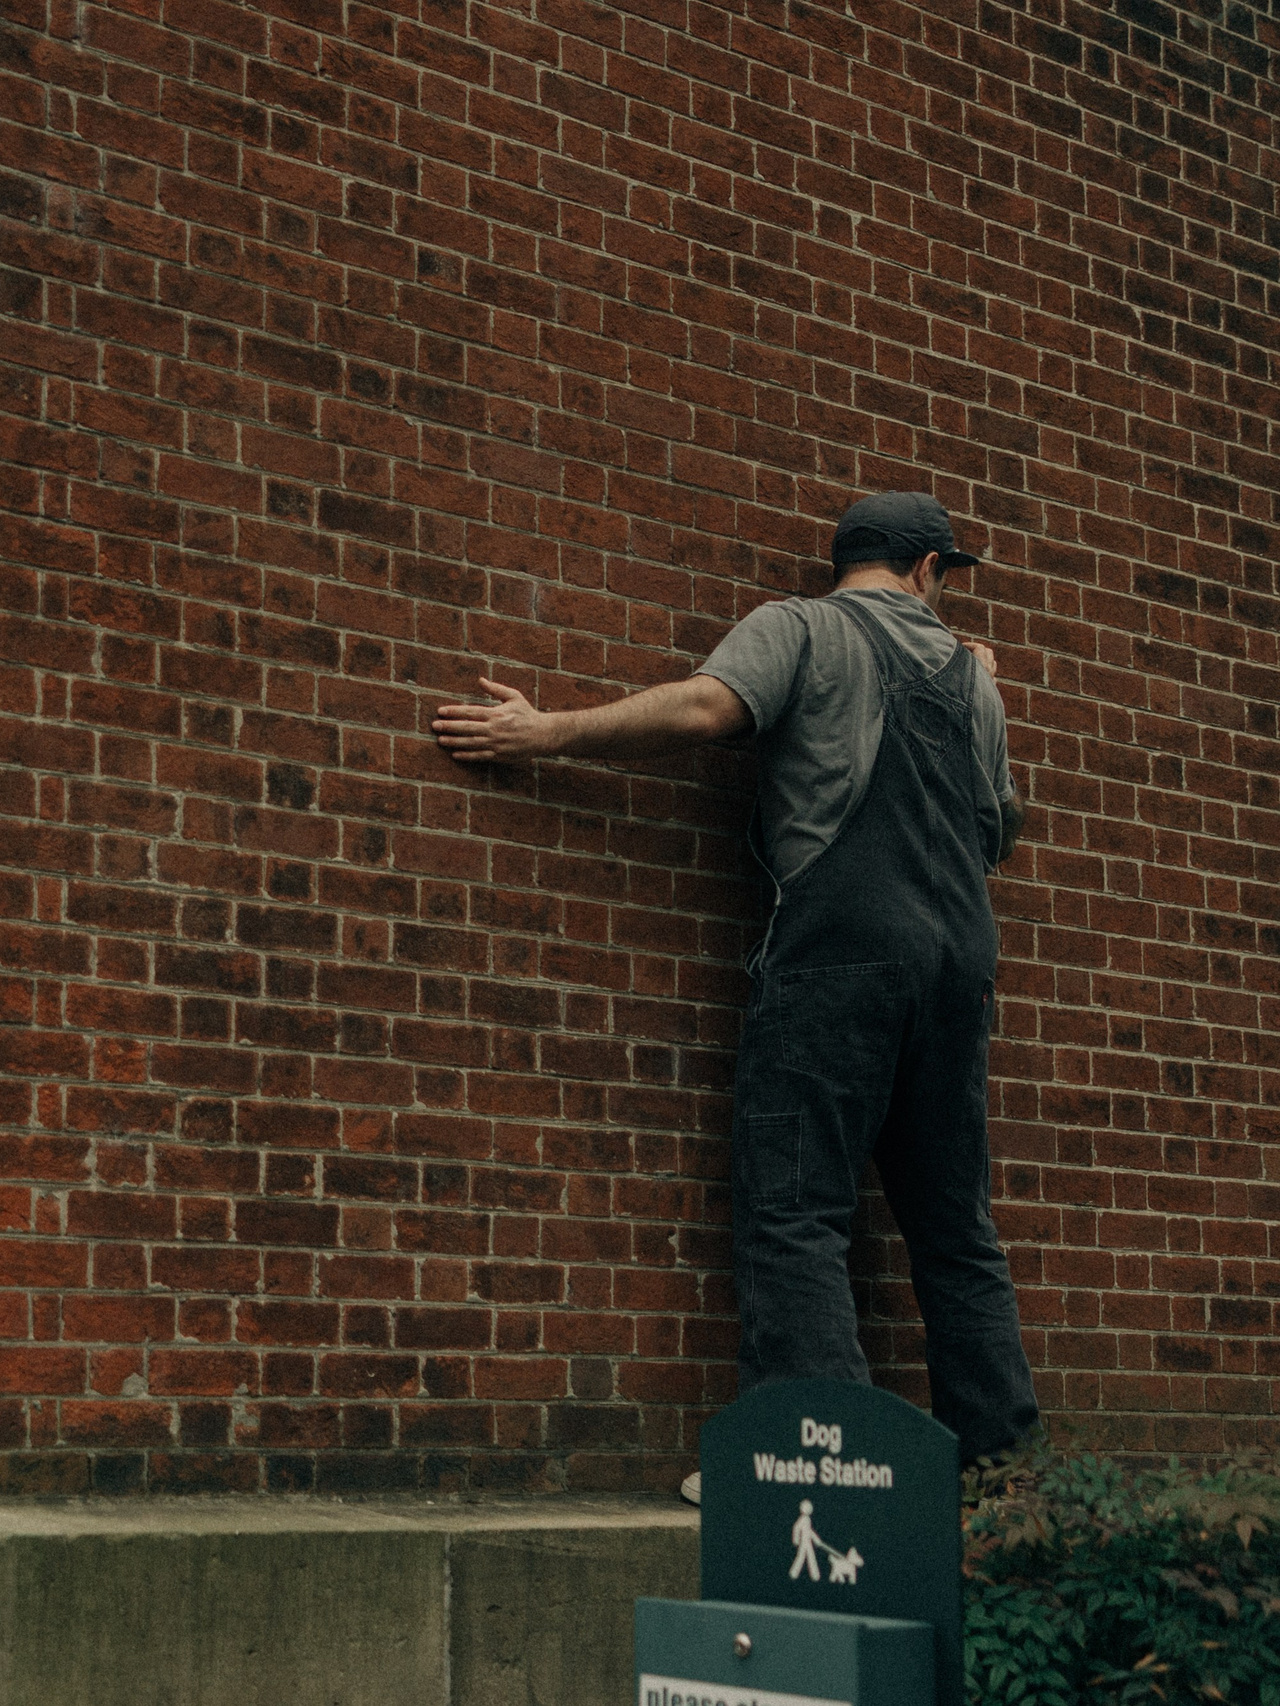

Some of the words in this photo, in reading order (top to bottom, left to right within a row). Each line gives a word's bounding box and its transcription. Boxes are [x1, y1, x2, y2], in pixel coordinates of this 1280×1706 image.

[801, 1417, 842, 1454] Dog
[754, 1452, 817, 1485] Waste
[820, 1455, 893, 1489] Station
